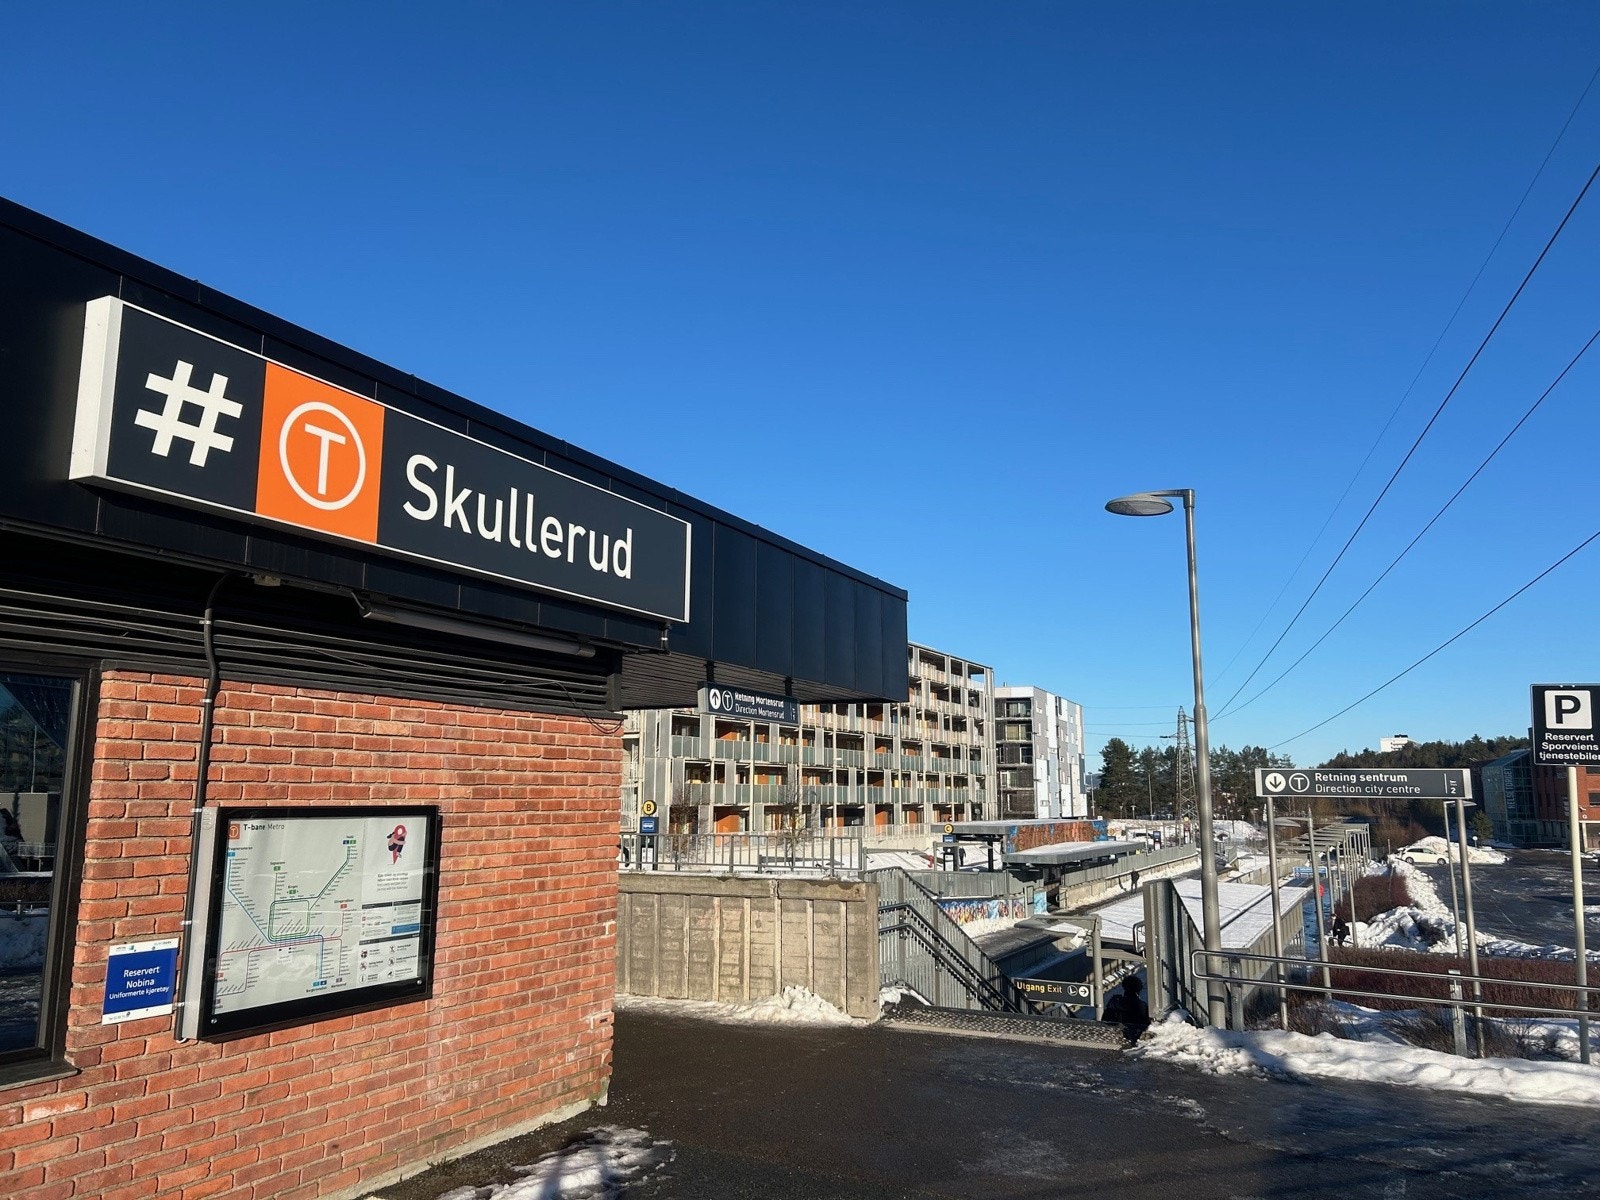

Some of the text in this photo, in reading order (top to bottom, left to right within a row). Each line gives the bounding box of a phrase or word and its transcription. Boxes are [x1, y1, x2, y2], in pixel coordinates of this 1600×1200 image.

[402, 454, 633, 580] Skullerud
[734, 692, 784, 708] Retning Mortensrud
[735, 704, 757, 714] Direction
[758, 708, 784, 720] Mortensrud
[1554, 695, 1581, 724] P
[1545, 732, 1594, 741] Reservert
[1542, 742, 1598, 751] Sporveiens
[1315, 773, 1408, 784] Retning sentrum
[1315, 784, 1420, 795] Direction city centre
[124, 966, 160, 978] Reservert
[126, 978, 155, 988] Nobina
[1016, 982, 1062, 994] Utgang Exit
[109, 986, 169, 1000] Uniformerte kjøretøy
